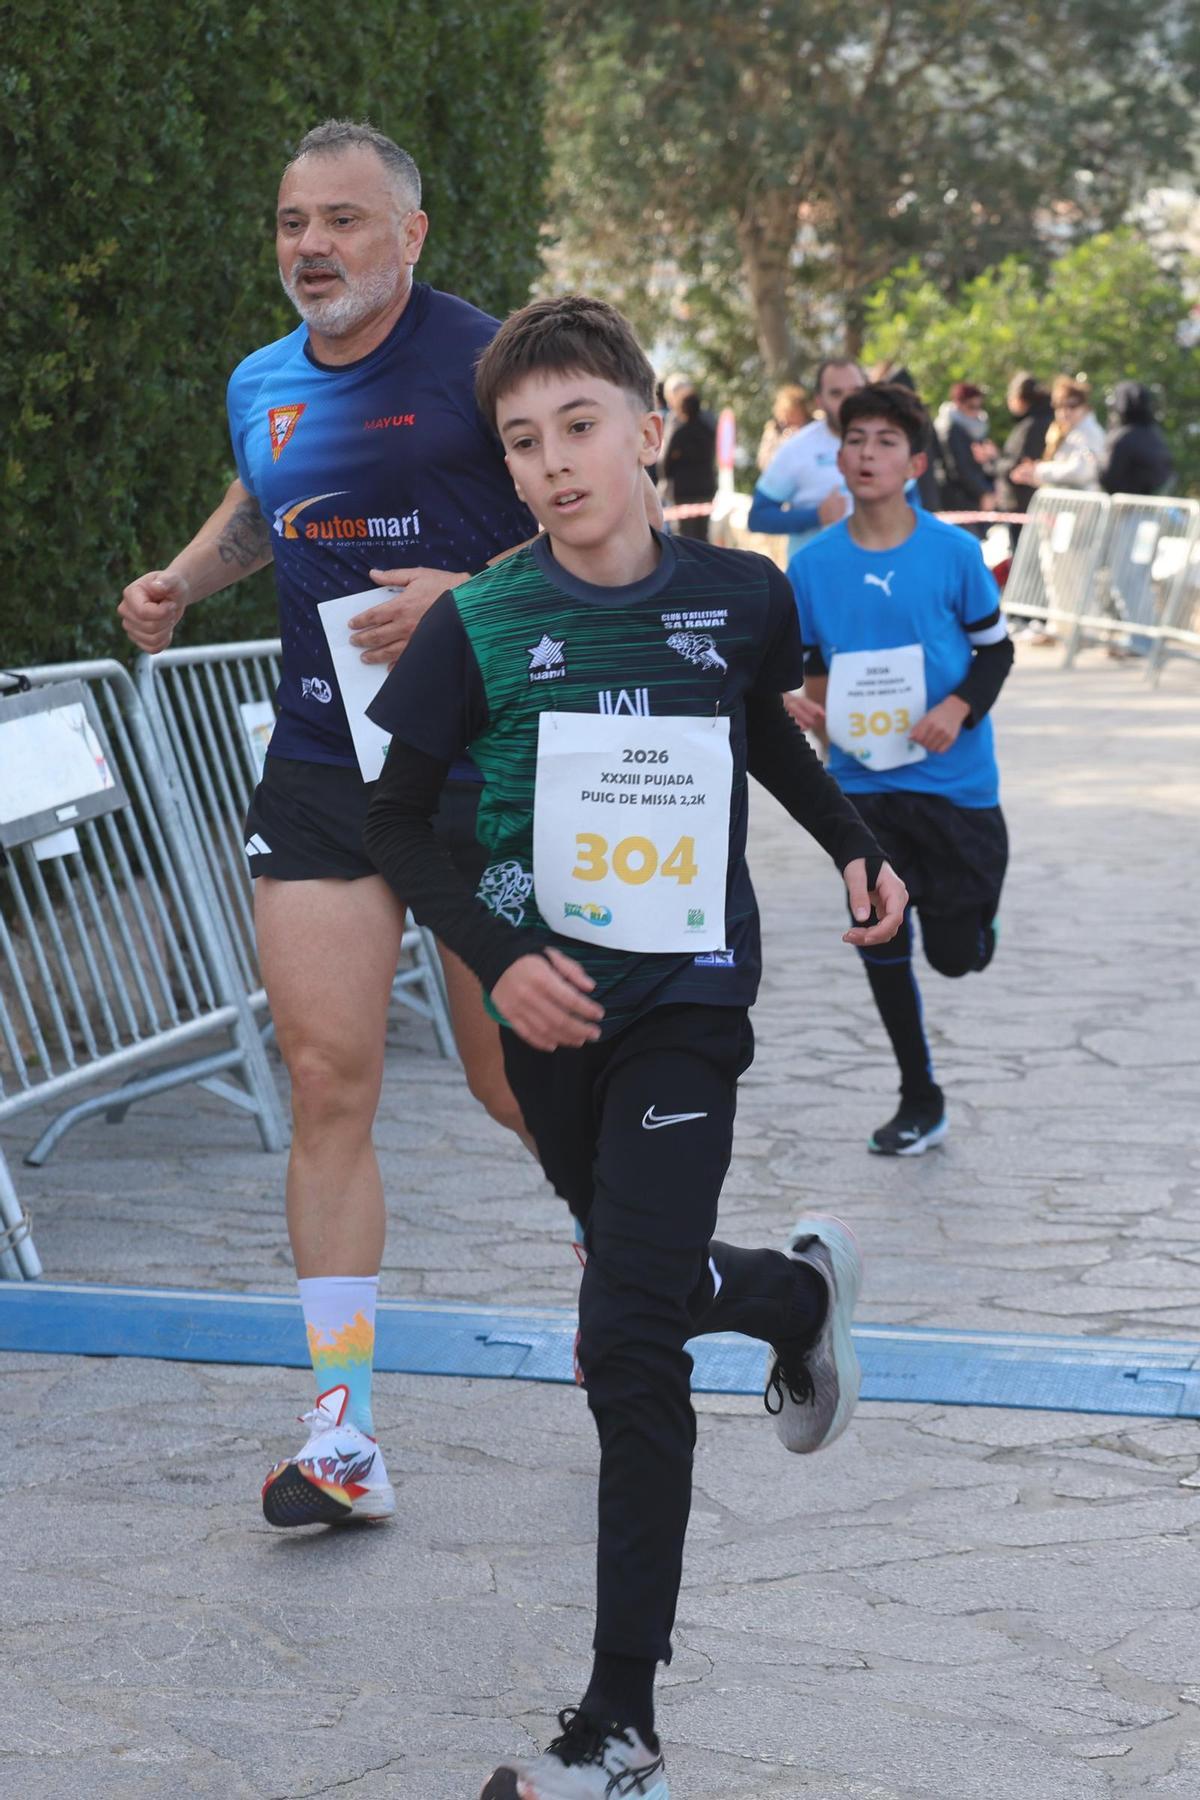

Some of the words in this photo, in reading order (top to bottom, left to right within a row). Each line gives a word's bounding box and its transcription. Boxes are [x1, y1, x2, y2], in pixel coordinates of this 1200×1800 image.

[306, 509, 420, 538] autosmarí
[685, 618, 727, 629] RAVAL
[848, 708, 910, 737] 303
[622, 749, 669, 764] 2026
[600, 771, 641, 786] XXXIII
[644, 774, 694, 787] PUJADA
[581, 790, 616, 804] PUIG
[618, 793, 638, 805] DE
[641, 793, 677, 806] MISSA
[680, 793, 706, 807] 2,2K
[571, 832, 698, 886] 304
